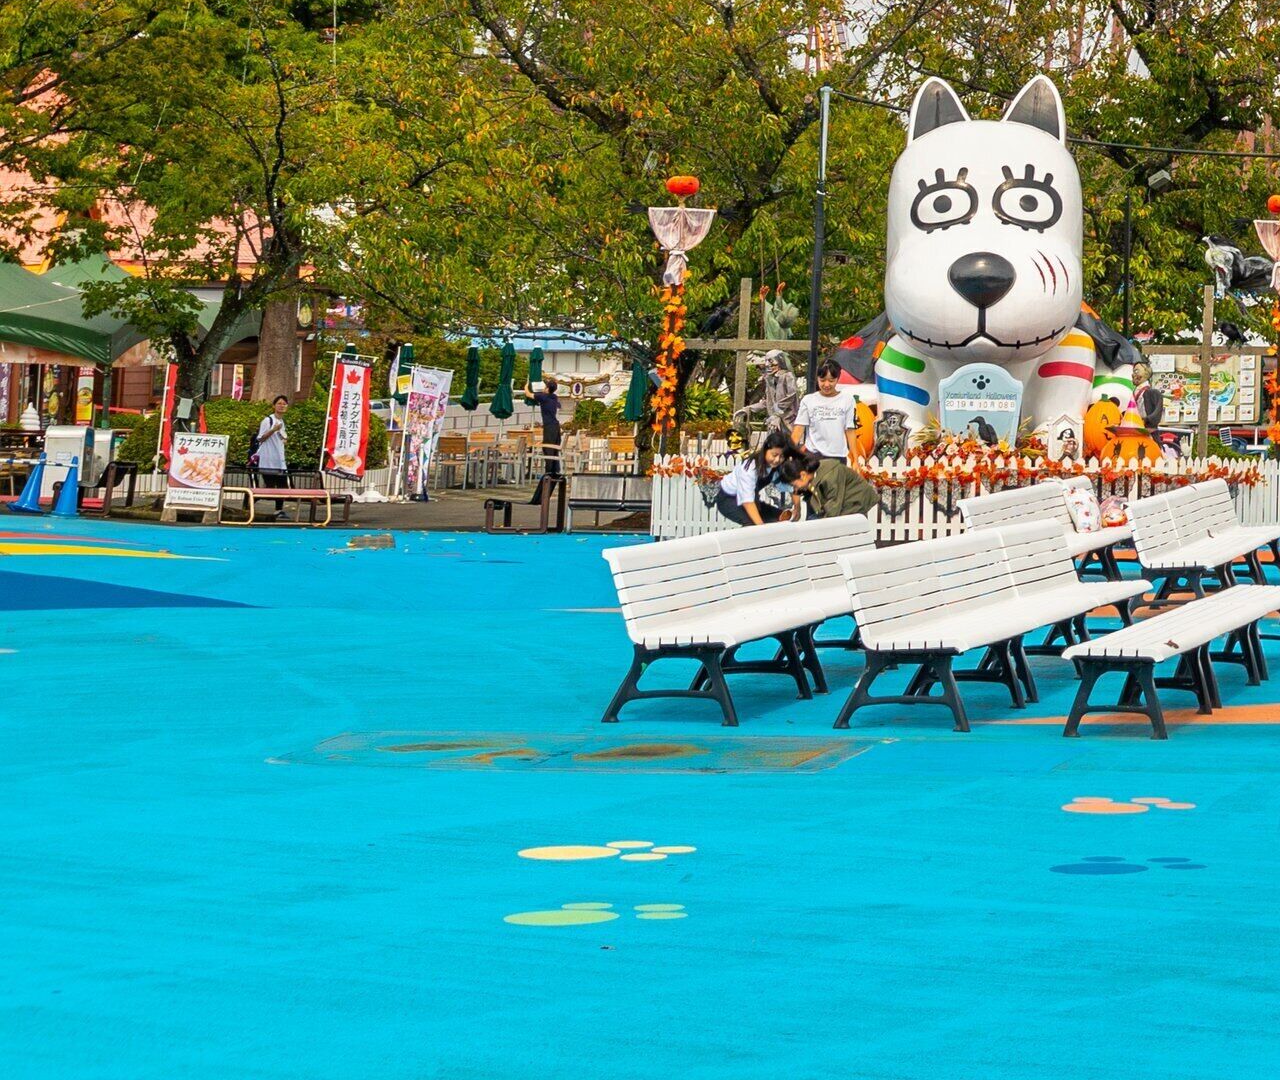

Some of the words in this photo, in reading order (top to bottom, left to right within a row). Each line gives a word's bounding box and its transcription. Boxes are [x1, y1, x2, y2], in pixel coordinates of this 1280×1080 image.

[348, 392, 361, 448] カナダポテト
[178, 437, 225, 449] カナダポテト
